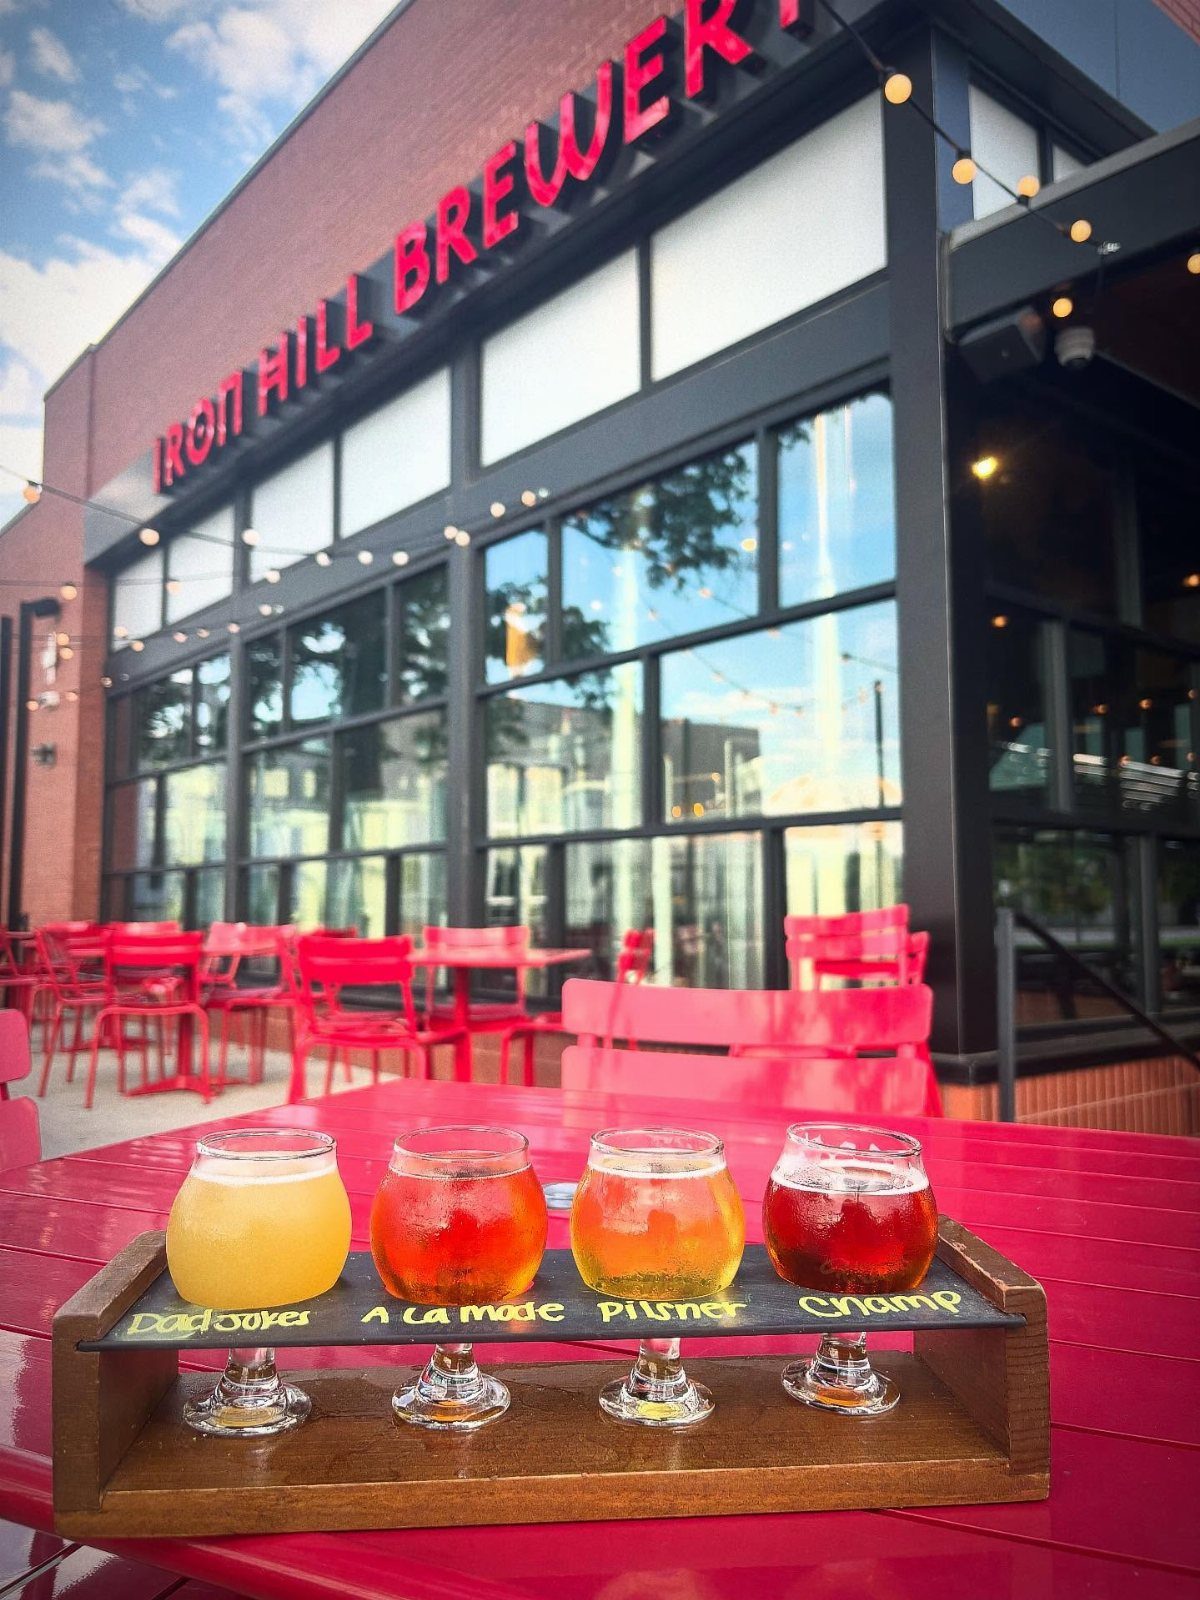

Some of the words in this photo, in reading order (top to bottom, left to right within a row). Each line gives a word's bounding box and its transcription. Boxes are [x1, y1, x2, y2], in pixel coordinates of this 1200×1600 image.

[153, 370, 243, 494] IRON
[257, 273, 373, 416] HILL
[126, 1308, 213, 1336] Dad
[360, 1306, 390, 1324] A
